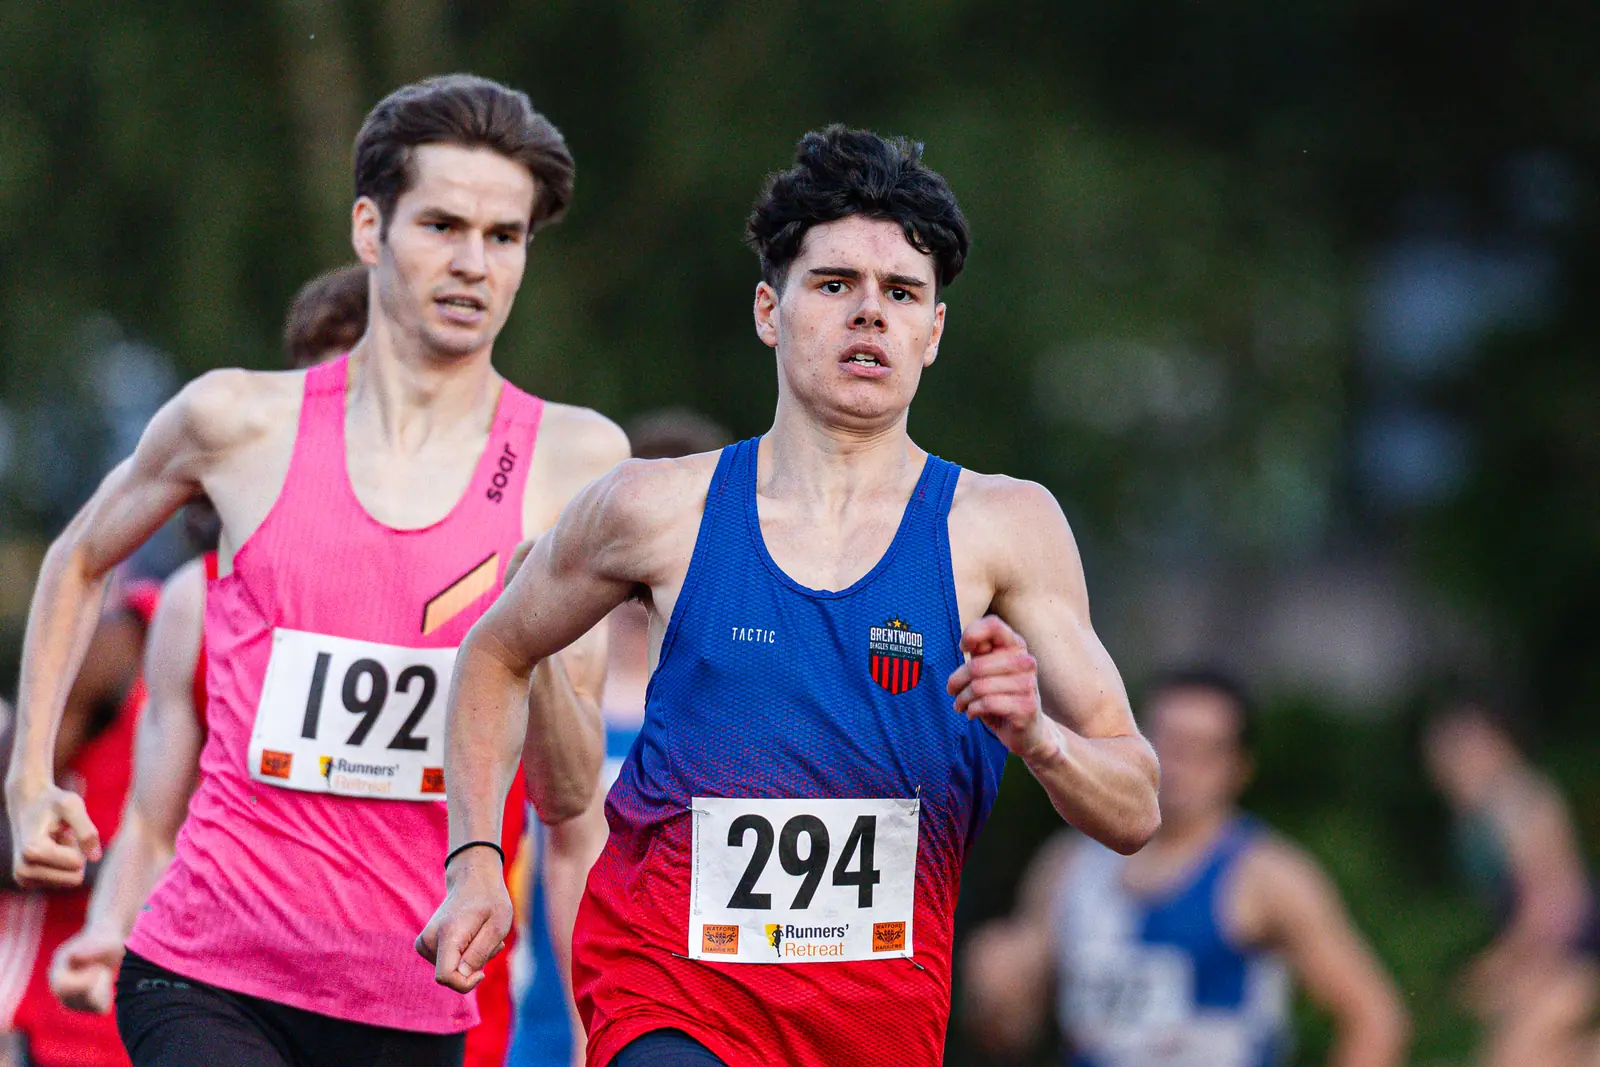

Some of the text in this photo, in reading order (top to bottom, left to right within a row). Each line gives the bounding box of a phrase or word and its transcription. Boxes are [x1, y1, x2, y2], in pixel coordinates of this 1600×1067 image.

[486, 441, 517, 504] soar
[731, 627, 776, 643] TACTIC
[870, 627, 923, 648] BRENTWOOD
[300, 651, 438, 751] 192
[726, 813, 881, 910] 294
[784, 923, 850, 939] Runners'
[784, 942, 845, 957] Retreat
